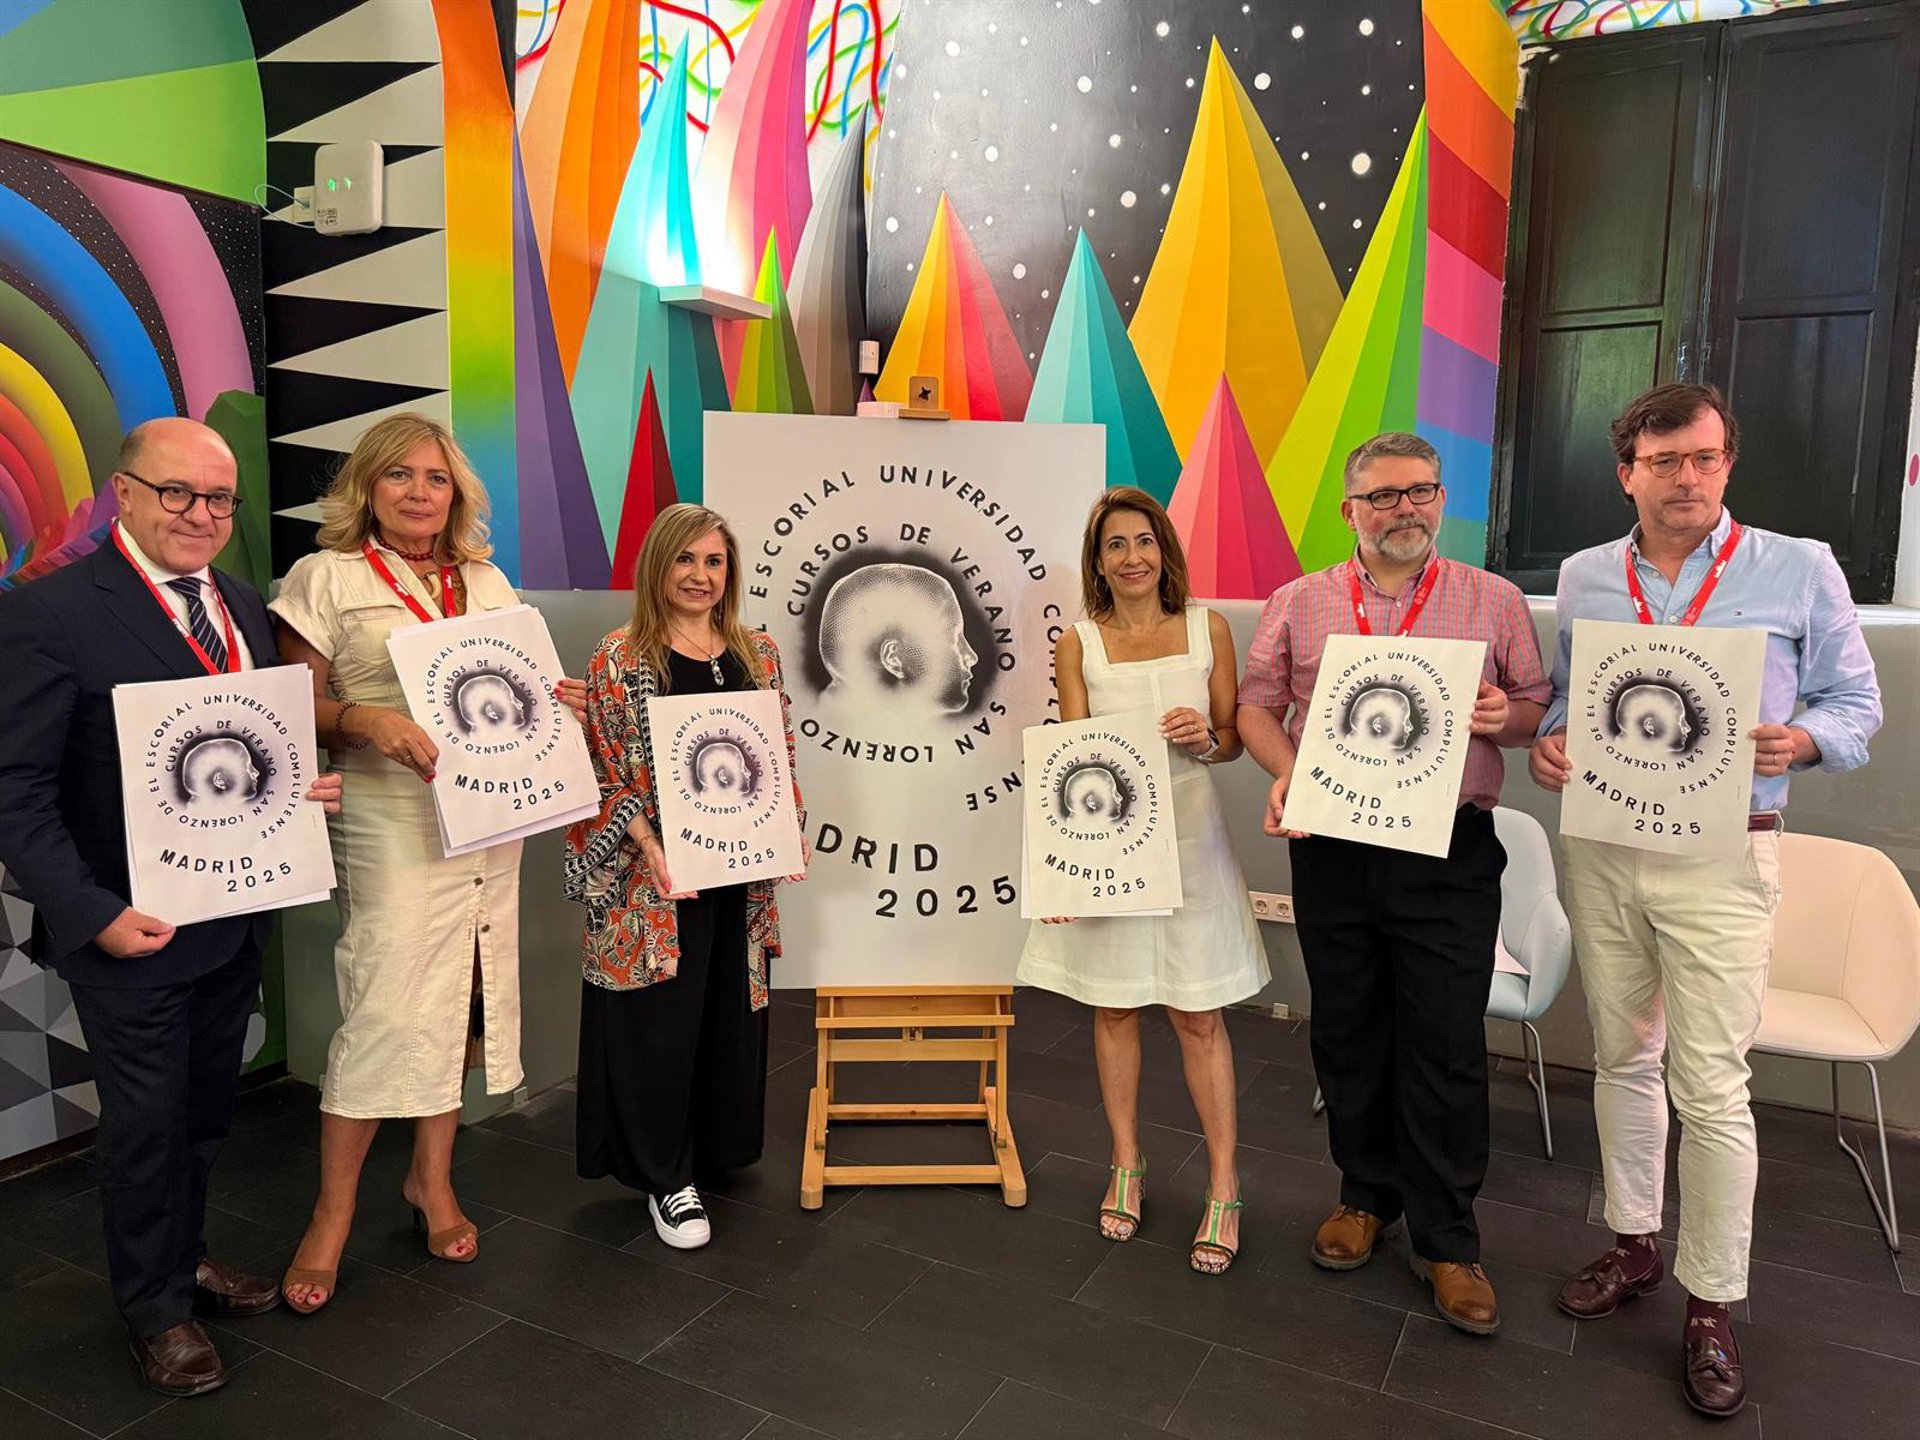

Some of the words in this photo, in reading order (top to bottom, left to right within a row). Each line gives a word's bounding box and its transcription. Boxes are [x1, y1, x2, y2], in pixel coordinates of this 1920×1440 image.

[749, 471, 855, 599] ESCORIAL
[880, 465, 1047, 582] UNIVERSIDAD
[900, 523, 931, 545] DE
[787, 526, 869, 617] CURSOS
[950, 547, 1016, 672] VERANO
[460, 637, 538, 670] UNIVERSIDAD
[477, 660, 489, 668] DE
[1587, 644, 1637, 695] ESCORIAL
[427, 647, 453, 703] ESCORIAL
[443, 665, 467, 706] CURSOS
[499, 664, 538, 706] VERANO
[1329, 654, 1378, 699] ESCORIAL
[1388, 652, 1450, 701] UNIVERSIDAD
[1390, 674, 1404, 682] DE
[1603, 668, 1642, 704] CURSOS
[1649, 643, 1730, 698] UNIVERSIDAD
[1656, 668, 1673, 679] DE
[1341, 674, 1379, 707] CURSOS
[203, 694, 287, 735] UNIVERSIDAD
[217, 720, 231, 729] DE
[433, 712, 444, 726] EL
[535, 676, 562, 762] COMPLUTENSE
[1325, 708, 1332, 719] EL
[1409, 684, 1430, 735] VERANO
[1587, 705, 1595, 717] EL
[1680, 680, 1710, 736] VERANO
[146, 703, 192, 767] ESCORIAL
[445, 731, 459, 745] DE
[525, 719, 540, 742] SAN
[671, 712, 702, 761] ESCORIAL
[709, 708, 769, 745] UNIVERSIDAD
[801, 719, 934, 763] LORENZO
[956, 701, 1006, 755] SAN
[1326, 727, 1335, 740] DE
[1590, 728, 1603, 741] DE
[166, 726, 202, 771] CURSOS
[242, 727, 276, 776] VERANO
[465, 742, 519, 754] LORENZO
[684, 731, 709, 766] CURSOS
[737, 735, 763, 777] VERANO
[1040, 739, 1074, 788] ESCORIAL
[1082, 733, 1146, 768] UNIVERSIDAD
[1336, 743, 1387, 767] LORENZO
[1397, 710, 1453, 789] COMPLUTENSE
[1397, 746, 1421, 766] SAN
[1606, 745, 1666, 771] LORENZO
[1677, 748, 1703, 770] SAN
[1679, 707, 1737, 794] COMPLUTENSE
[149, 778, 159, 792] EL
[261, 743, 300, 839] COMPLUTENSE
[455, 774, 532, 793] MADRID
[672, 771, 679, 781] EL
[754, 751, 781, 828] COMPLUTENSE
[1053, 756, 1080, 793] CURSOS
[1108, 759, 1137, 802] VERANO
[1310, 767, 1382, 809] MADRID
[158, 800, 174, 815] DE
[253, 790, 274, 816] SAN
[513, 781, 565, 810] 2025
[679, 788, 690, 800] DE
[694, 801, 742, 814] LORENZO
[747, 788, 763, 809] SAN
[1041, 796, 1048, 807] EL
[1582, 770, 1665, 816] MADRID
[179, 815, 243, 827] LORENZO
[1046, 815, 1057, 827] DE
[1117, 813, 1135, 834] SAN
[1123, 775, 1157, 855] COMPLUTENSE
[1351, 812, 1412, 828] 2025
[1635, 819, 1701, 835] 2025
[680, 828, 748, 853] MADRID
[802, 811, 938, 874] DRID
[1061, 827, 1109, 840] LORENZO
[159, 850, 252, 873] MADRID
[728, 848, 775, 868] 2025
[1045, 854, 1114, 881] MADRID
[227, 862, 291, 892] 2025
[1093, 878, 1145, 897] 2025
[875, 875, 1016, 918] 2025
